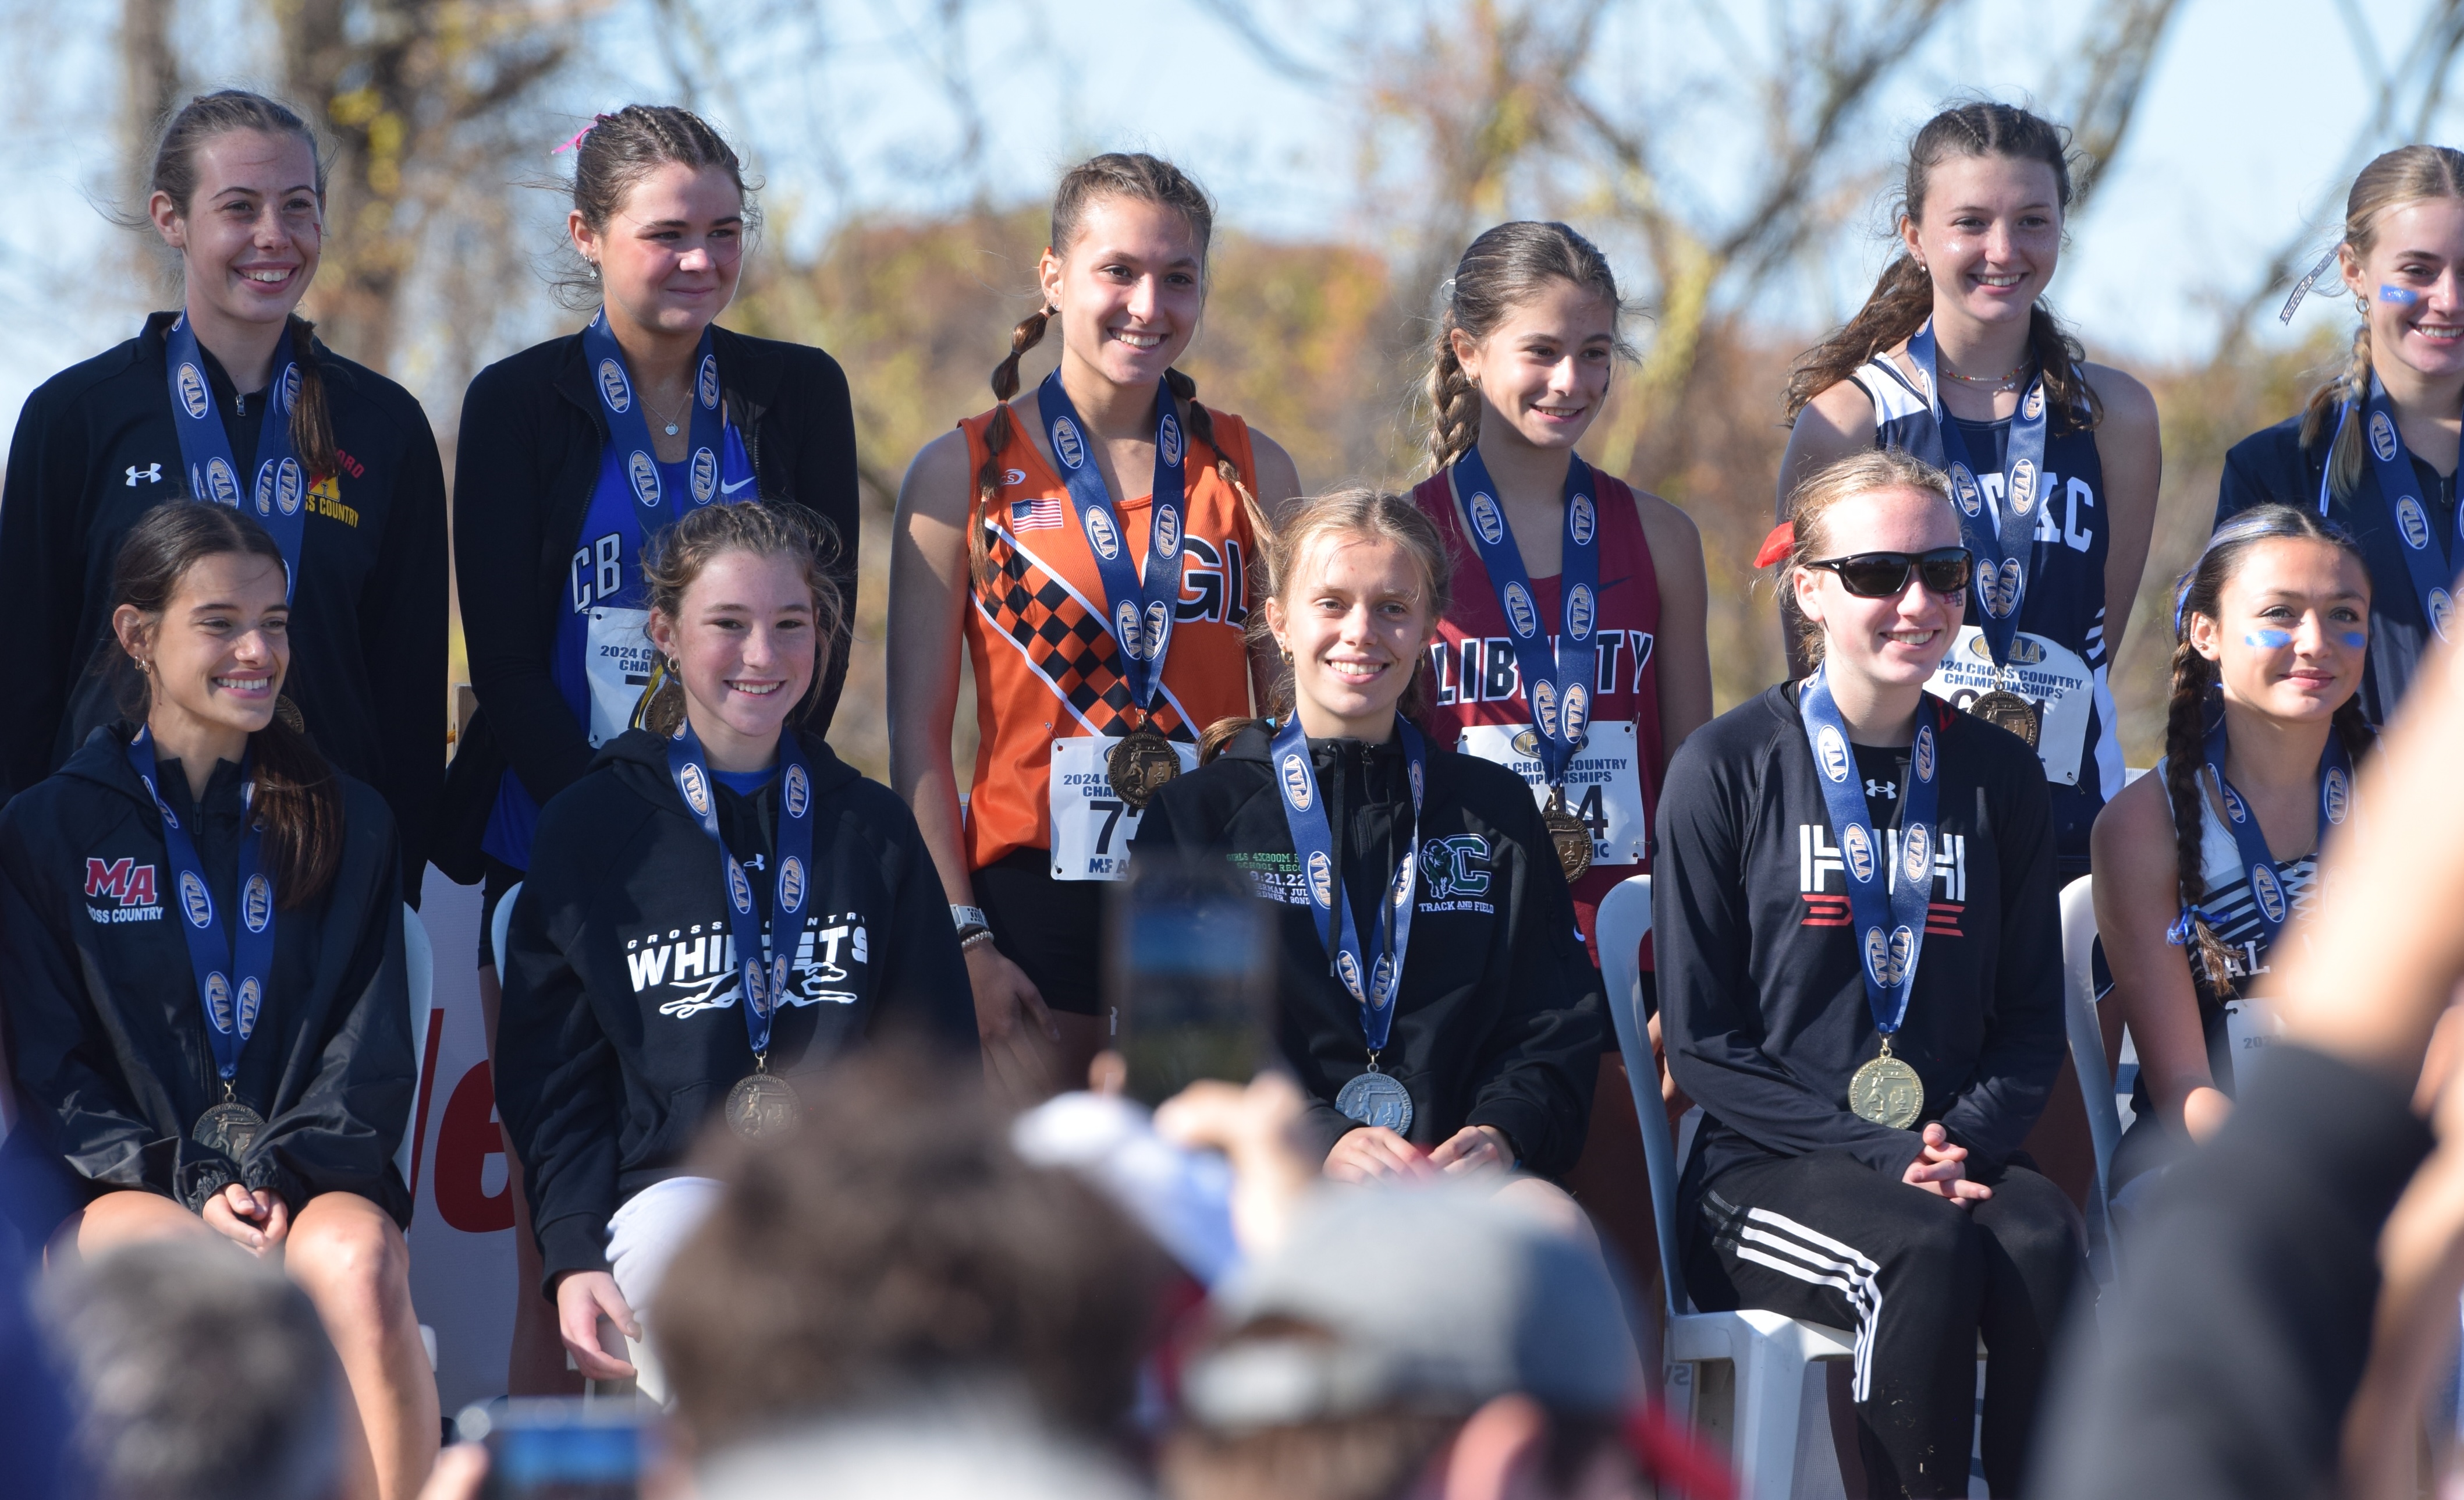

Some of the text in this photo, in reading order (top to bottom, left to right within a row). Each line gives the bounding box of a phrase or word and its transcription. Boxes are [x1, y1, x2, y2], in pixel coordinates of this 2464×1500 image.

[181, 366, 206, 416] PIAA
[601, 361, 629, 409] PIAA
[702, 359, 716, 406] PIAA
[1056, 419, 1081, 466] PIAA
[1164, 418, 1178, 464] PIAA
[2373, 414, 2395, 459] PIAA
[278, 463, 297, 512] PIAA
[633, 453, 658, 503] PIAA
[695, 453, 712, 499] PIAA
[1955, 464, 1977, 513] PIAA
[2014, 464, 2033, 513] PIAA
[320, 498, 359, 528] COUNTRY
[1089, 509, 1116, 557] PIAA
[1159, 509, 1176, 556] PIAA
[1473, 494, 1500, 541] PIAA
[1575, 496, 1593, 541] PIAA
[2399, 499, 2427, 547] PIAA
[1506, 584, 1534, 635] PIAA
[1572, 586, 1593, 636] PIAA
[1998, 563, 2018, 615] PIAA
[600, 644, 638, 658] 2024
[1144, 607, 1164, 655] PIAA
[1431, 630, 1653, 706] LIBTY
[1944, 673, 2063, 700] CHAMPONSHIPS
[2019, 669, 2083, 690] COUNTRY
[1567, 685, 1588, 738] PIAA
[1919, 730, 1932, 780] PIAA
[683, 767, 707, 813] PIAA
[790, 767, 806, 813] PIAA
[1064, 774, 1100, 785] 2024
[1286, 757, 1311, 808] PIAA
[2330, 772, 2346, 819] PIAA
[1226, 853, 1249, 861] GIRLS
[1236, 861, 1273, 871] SCHOOL
[1848, 827, 1872, 880] PIAA
[1907, 827, 1926, 880] PIAA
[85, 857, 158, 906] MA
[183, 873, 208, 924] PIAA
[247, 876, 267, 928] PIAA
[783, 859, 801, 907] PIAA
[2256, 867, 2282, 920] PIAA
[112, 906, 164, 923] COUNTRY
[1419, 900, 1494, 914] TRACK AND FIELD
[627, 921, 722, 949] CROSS
[1870, 929, 1887, 985] PIAA
[209, 974, 232, 1030] PIAA
[241, 978, 258, 1034] PIAA
